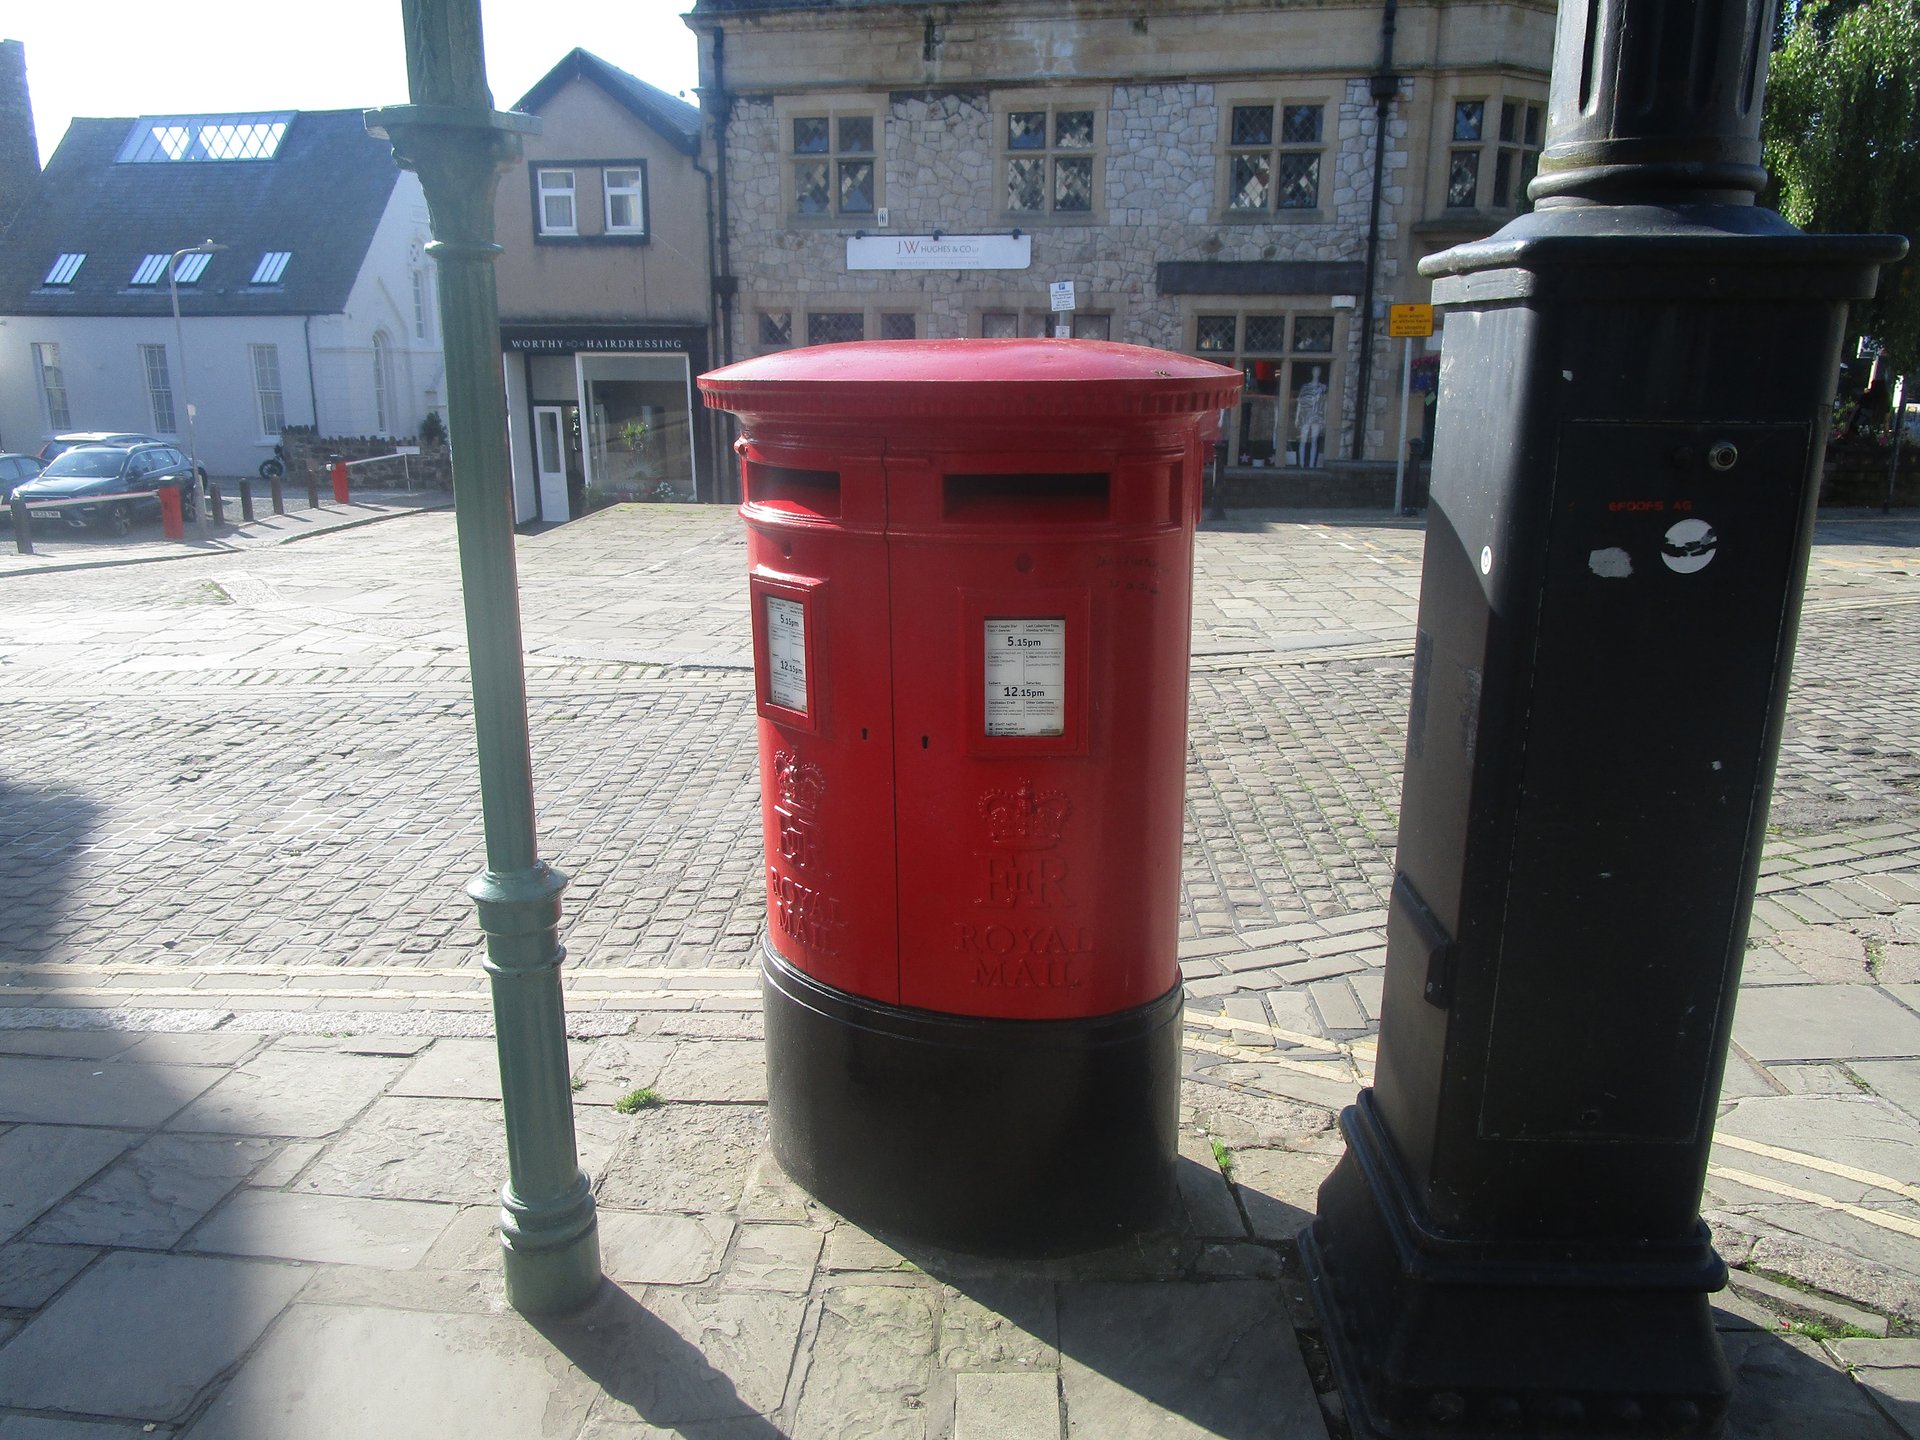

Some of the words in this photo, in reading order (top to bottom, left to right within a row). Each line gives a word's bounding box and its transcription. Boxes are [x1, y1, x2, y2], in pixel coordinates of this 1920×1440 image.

[903, 240, 920, 254] W
[921, 245, 951, 253] HUGHES
[952, 245, 958, 253] &
[959, 245, 972, 253] CO
[512, 340, 563, 348] WORTHY
[586, 340, 682, 348] HAIRDRESSING
[1007, 636, 1041, 648] 5.15pm
[1004, 686, 1045, 698] 12.15pm
[770, 866, 848, 928] ROYAL
[777, 901, 838, 956] MAIL
[955, 923, 1095, 954] ROYAL
[971, 957, 1081, 988] MAIL
